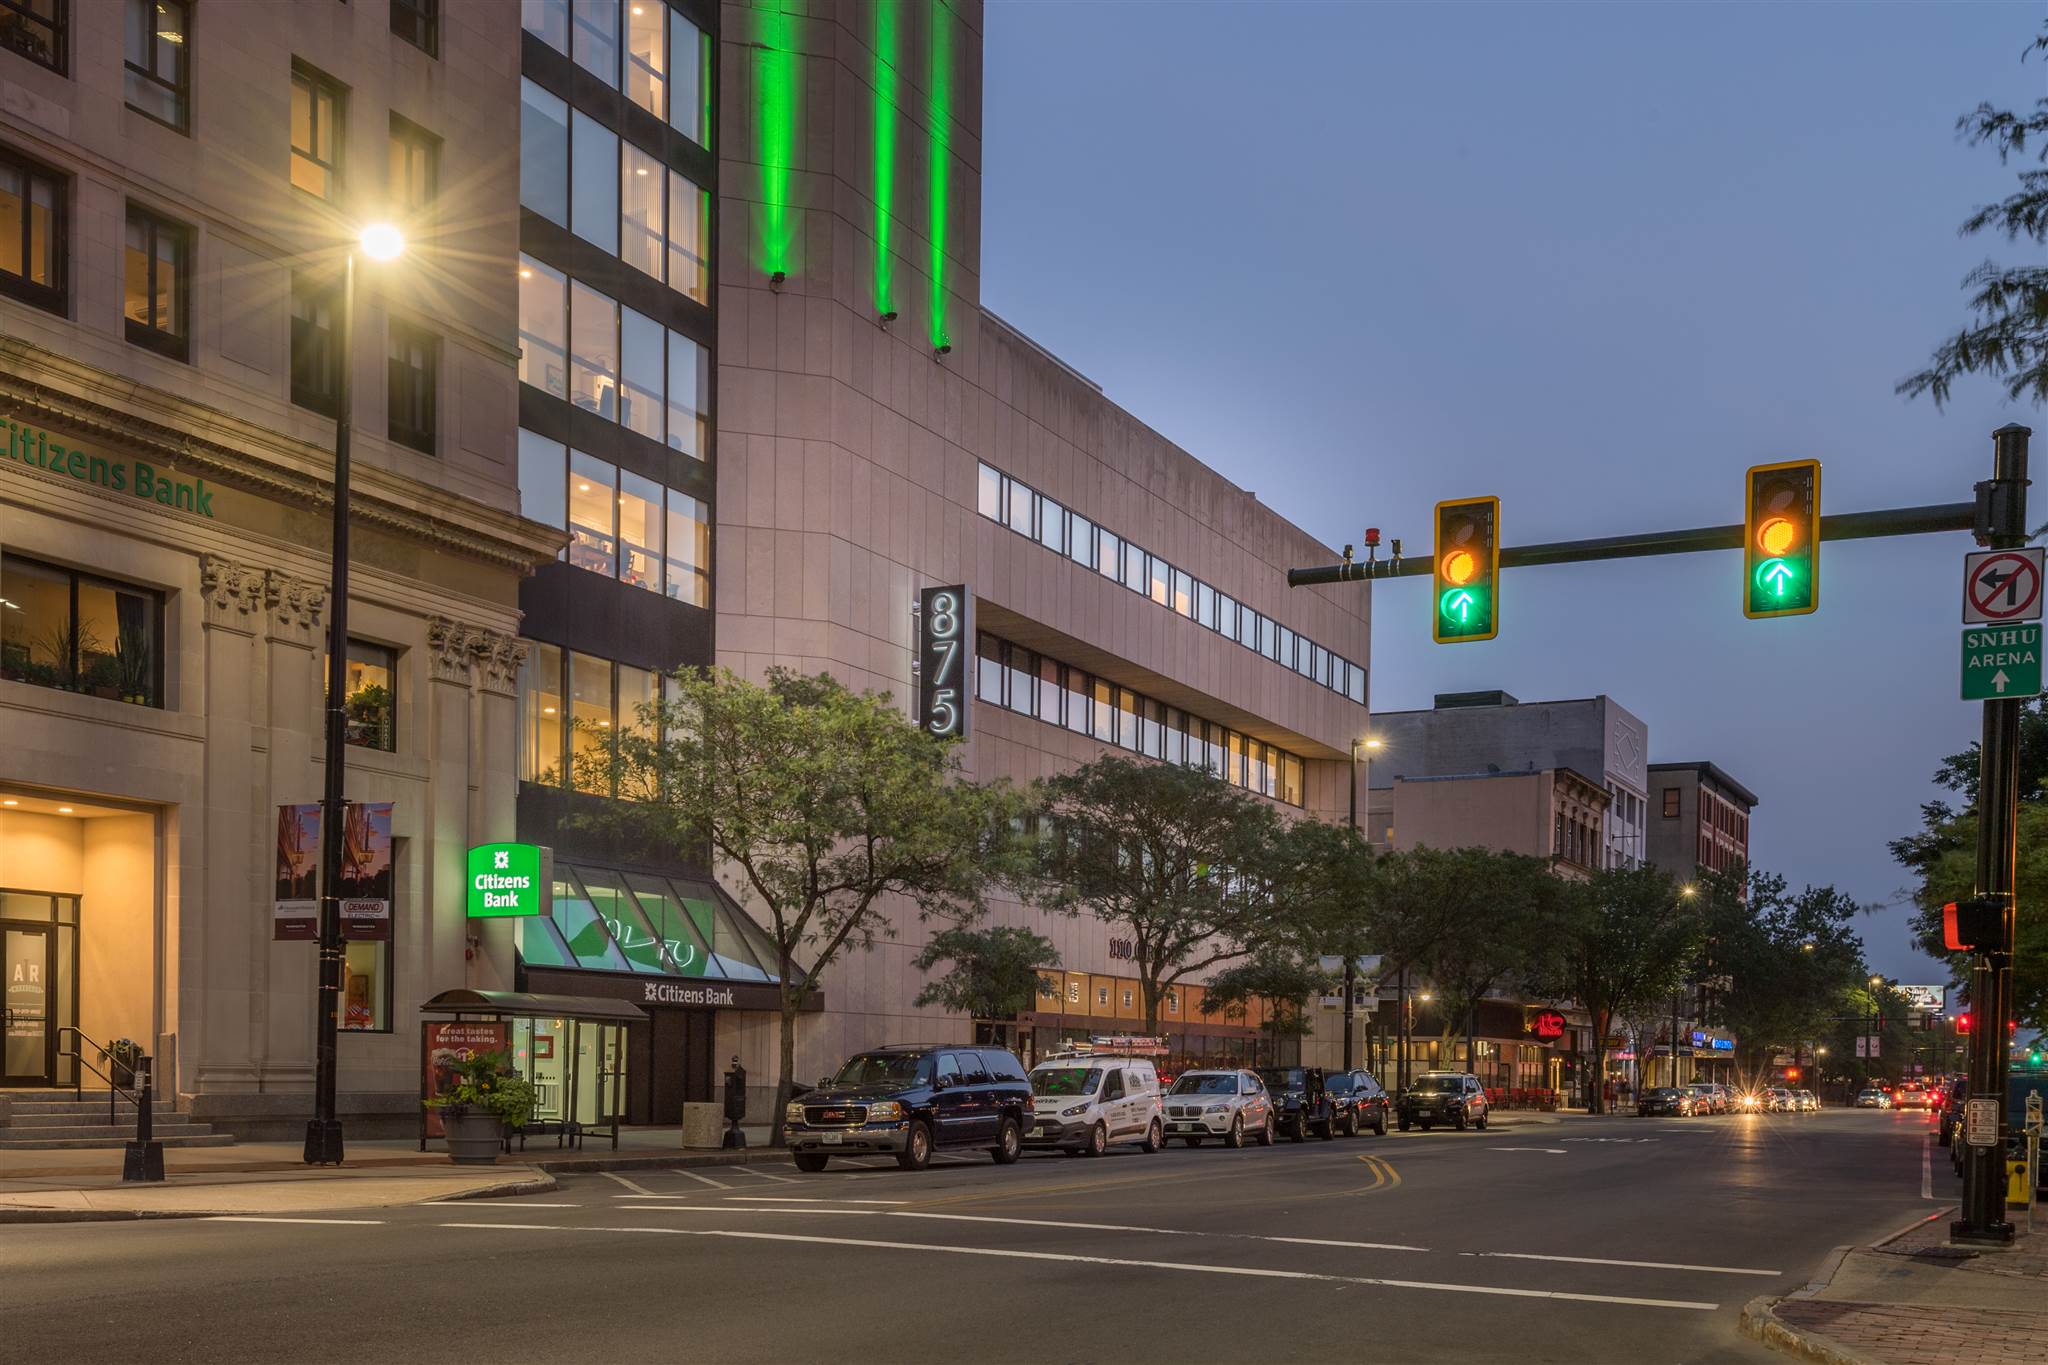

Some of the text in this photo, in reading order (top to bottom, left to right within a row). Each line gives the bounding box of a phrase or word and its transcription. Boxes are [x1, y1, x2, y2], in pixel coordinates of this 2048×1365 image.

[135, 461, 214, 518] Bank
[1967, 629, 2037, 648] SNHU
[930, 592, 957, 733] 875
[1968, 651, 2036, 668] ARENA
[475, 874, 530, 890] Citizens
[484, 890, 519, 908] Bank
[658, 984, 734, 1006] Citizens Bank
[436, 1034, 449, 1042] for
[451, 1034, 465, 1042] the
[467, 1027, 494, 1035] tastes
